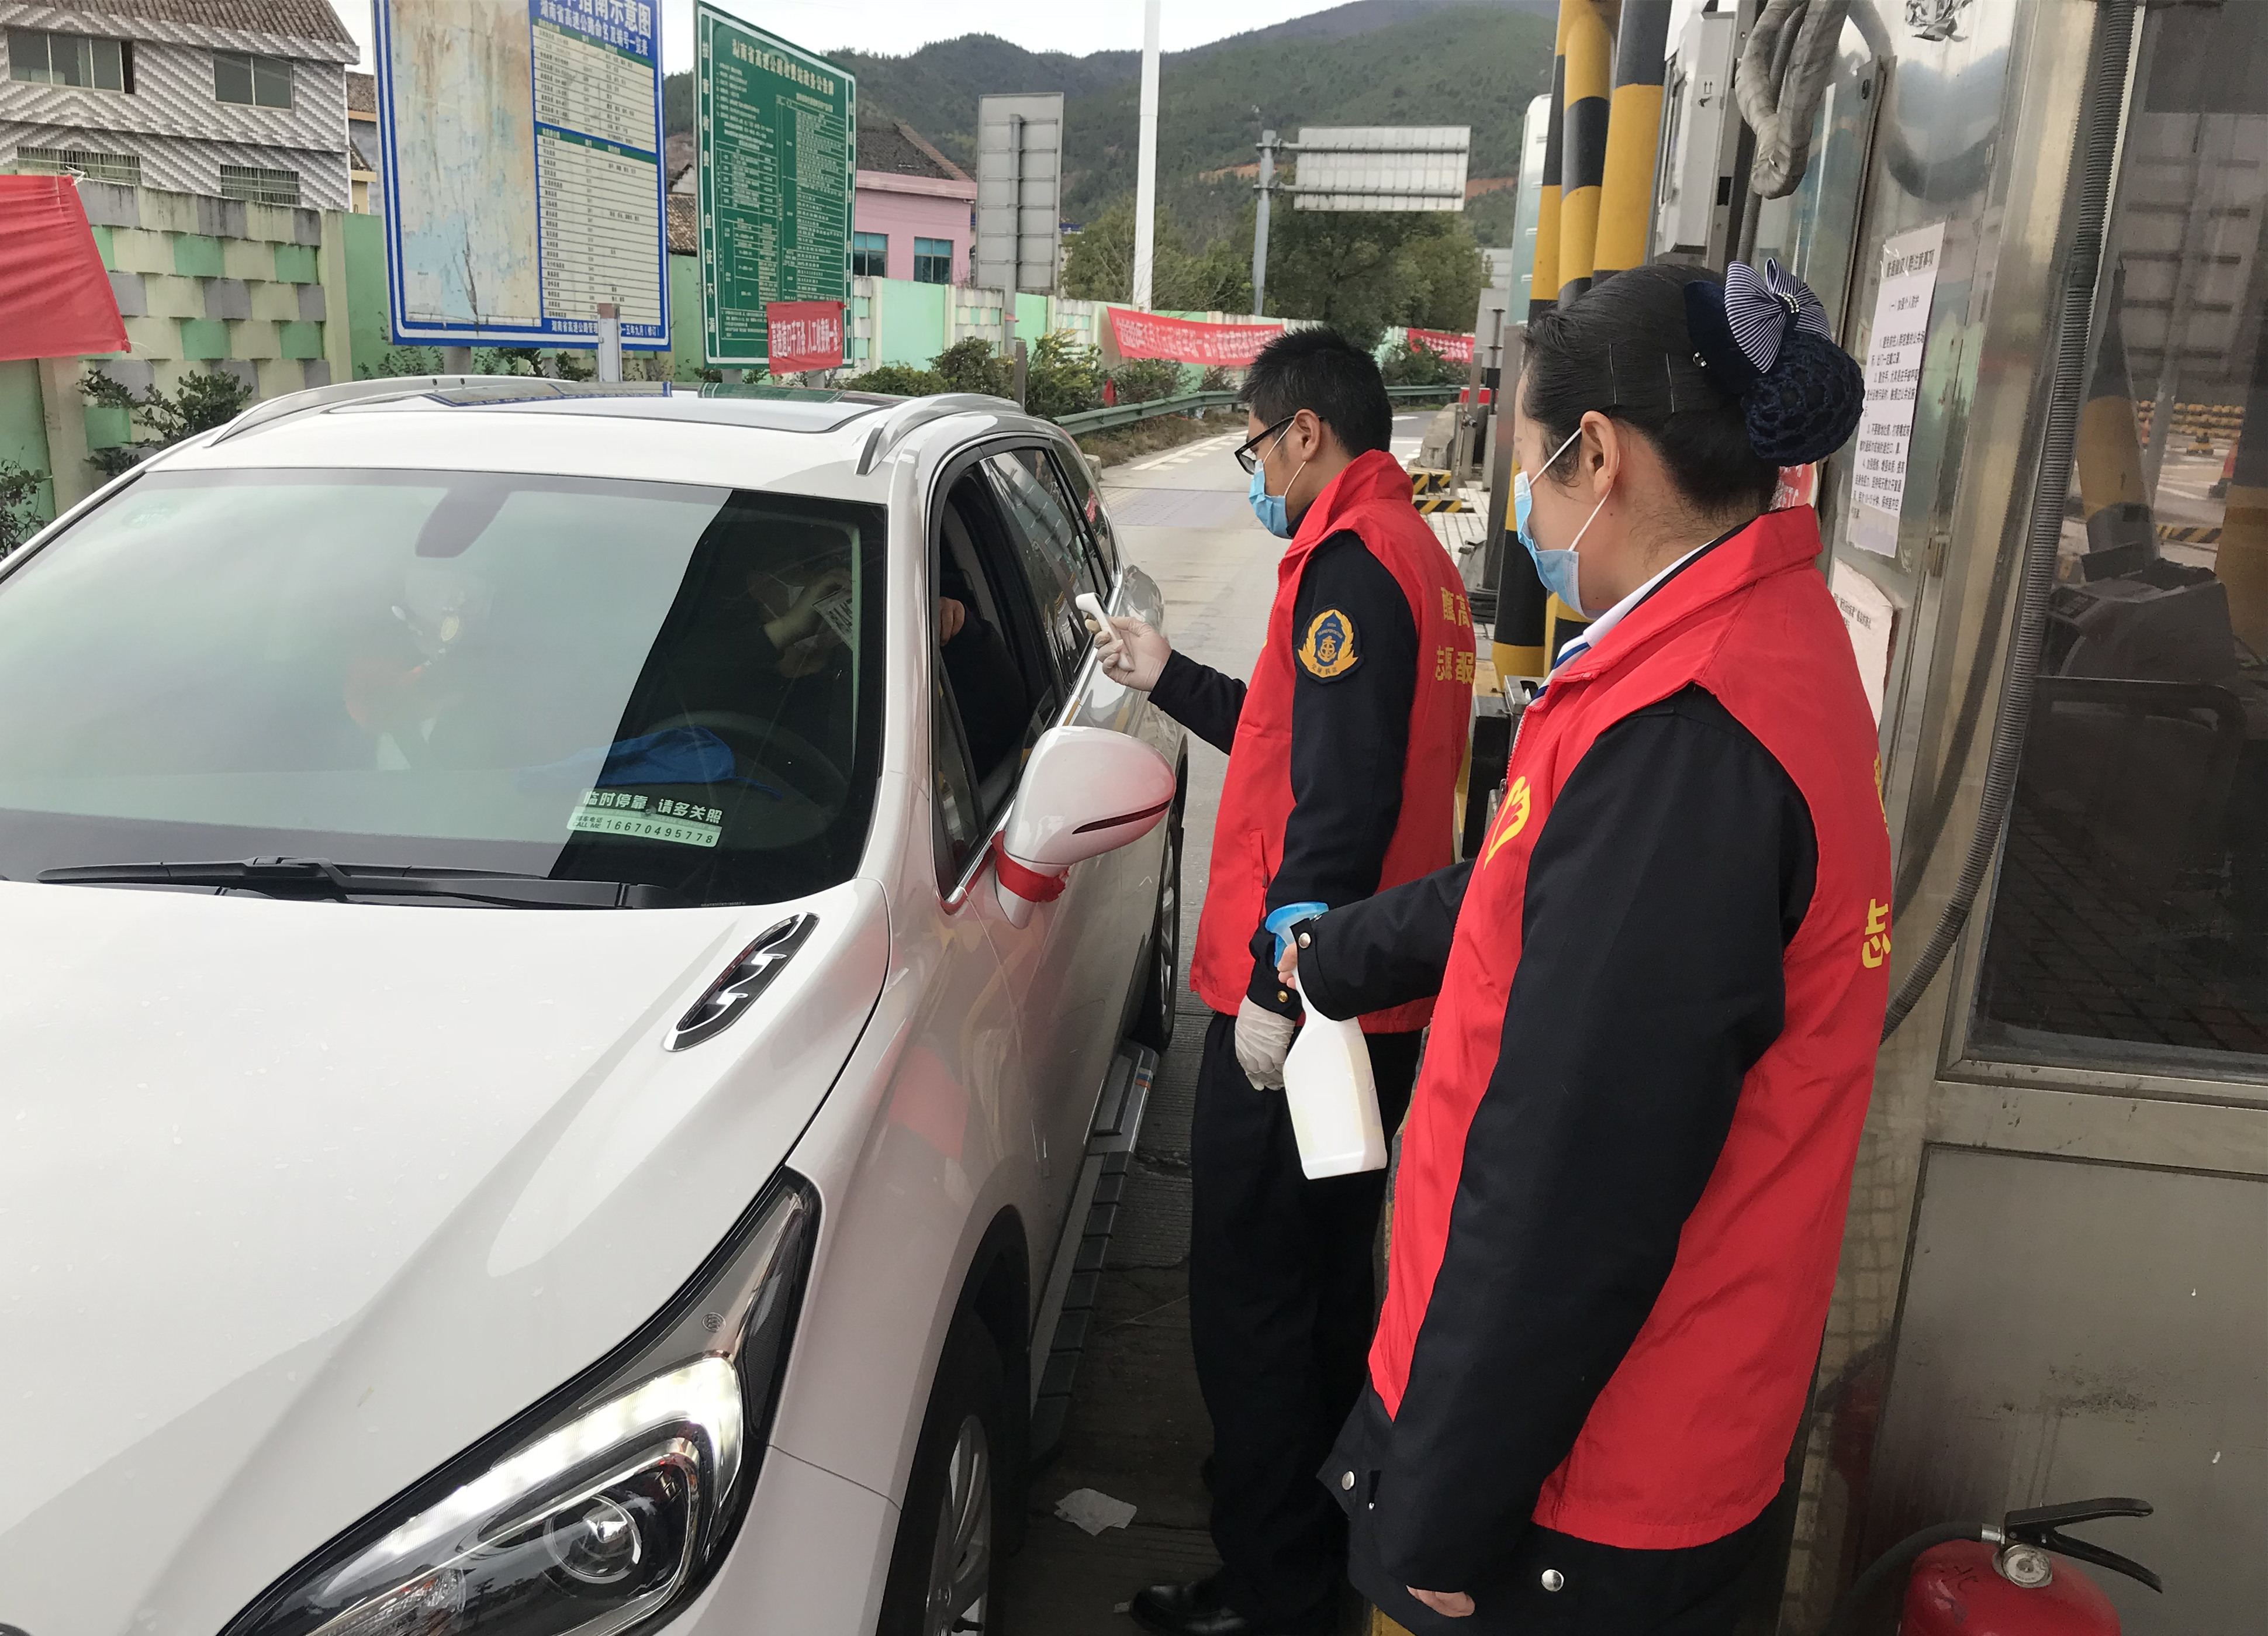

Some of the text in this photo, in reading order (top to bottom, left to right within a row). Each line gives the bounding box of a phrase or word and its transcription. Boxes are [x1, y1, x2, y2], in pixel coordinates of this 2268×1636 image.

[583, 791, 722, 824] 临时停靠 请多关照
[607, 819, 713, 844] 16670495778
